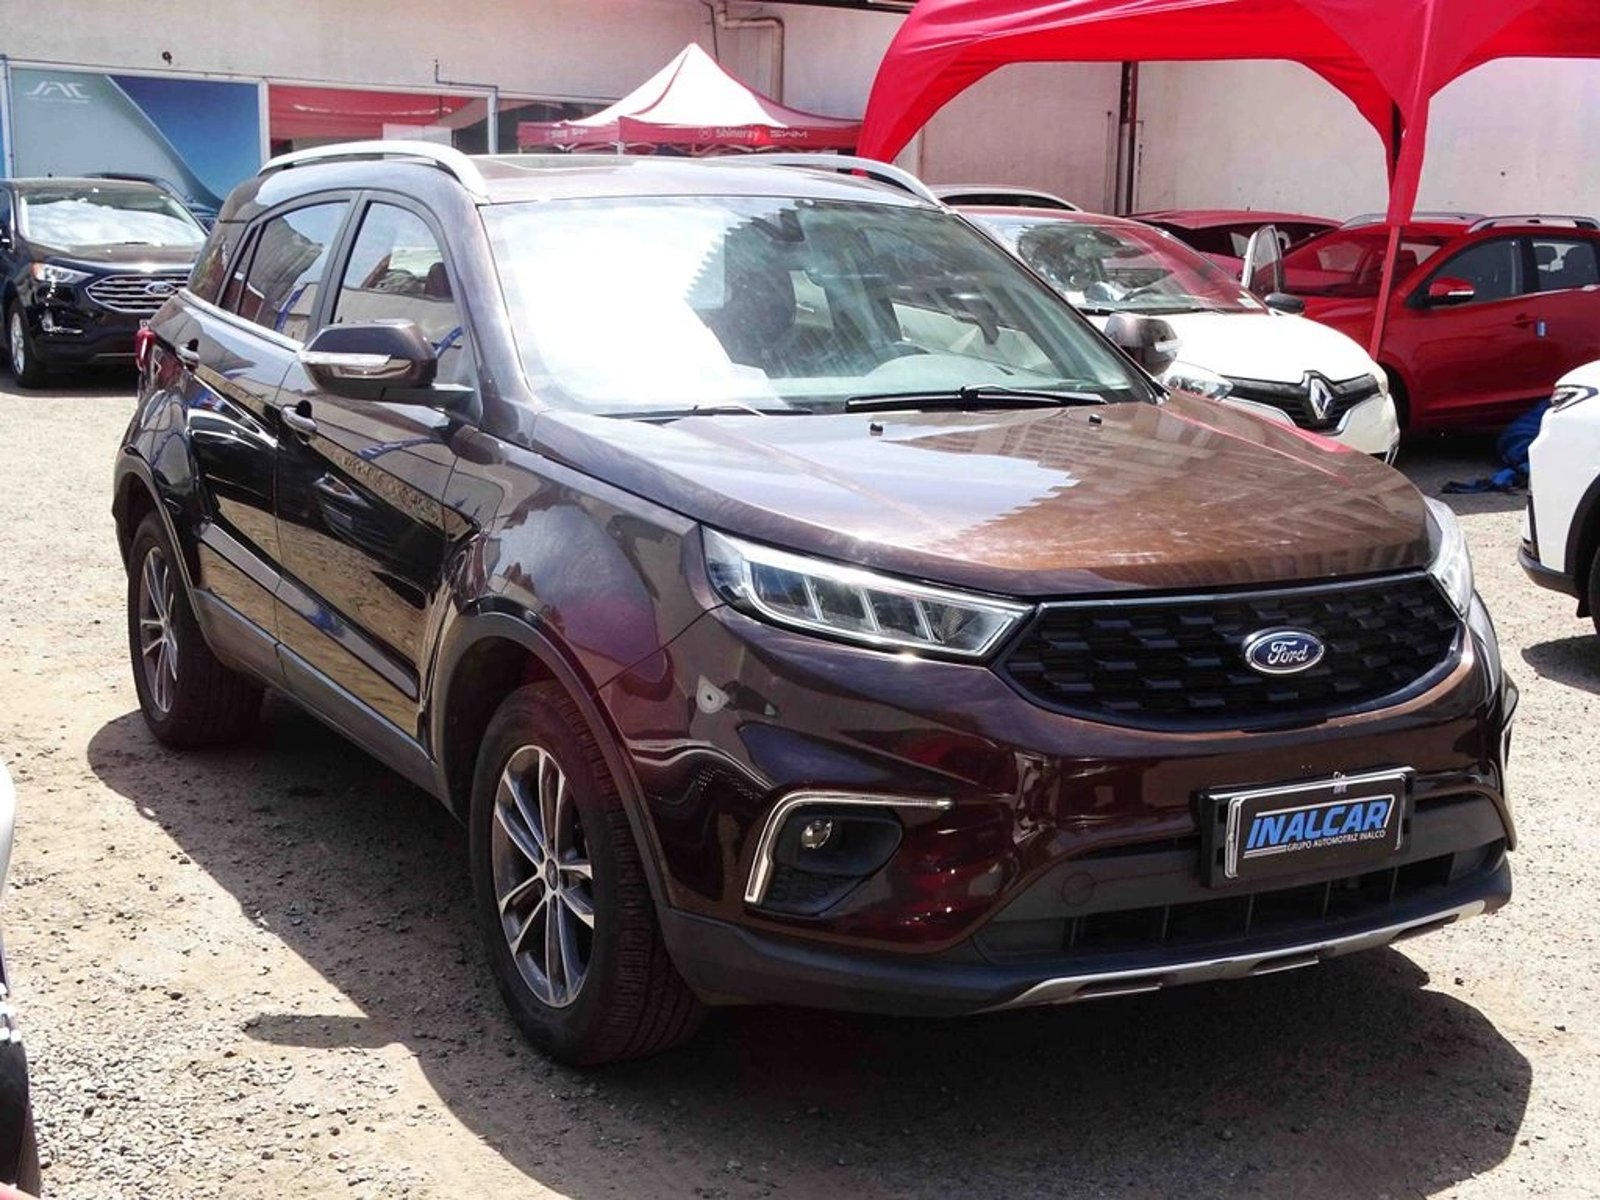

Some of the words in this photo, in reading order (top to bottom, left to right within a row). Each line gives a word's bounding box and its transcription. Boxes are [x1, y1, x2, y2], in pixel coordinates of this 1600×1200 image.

[25, 80, 91, 100] JAC
[1267, 640, 1309, 665] Ford
[1246, 800, 1388, 849] INALCAR
[1287, 841, 1312, 852] GRUPO
[1313, 833, 1358, 848] AUTOMOTRIZ
[1359, 829, 1386, 841] INALCO
